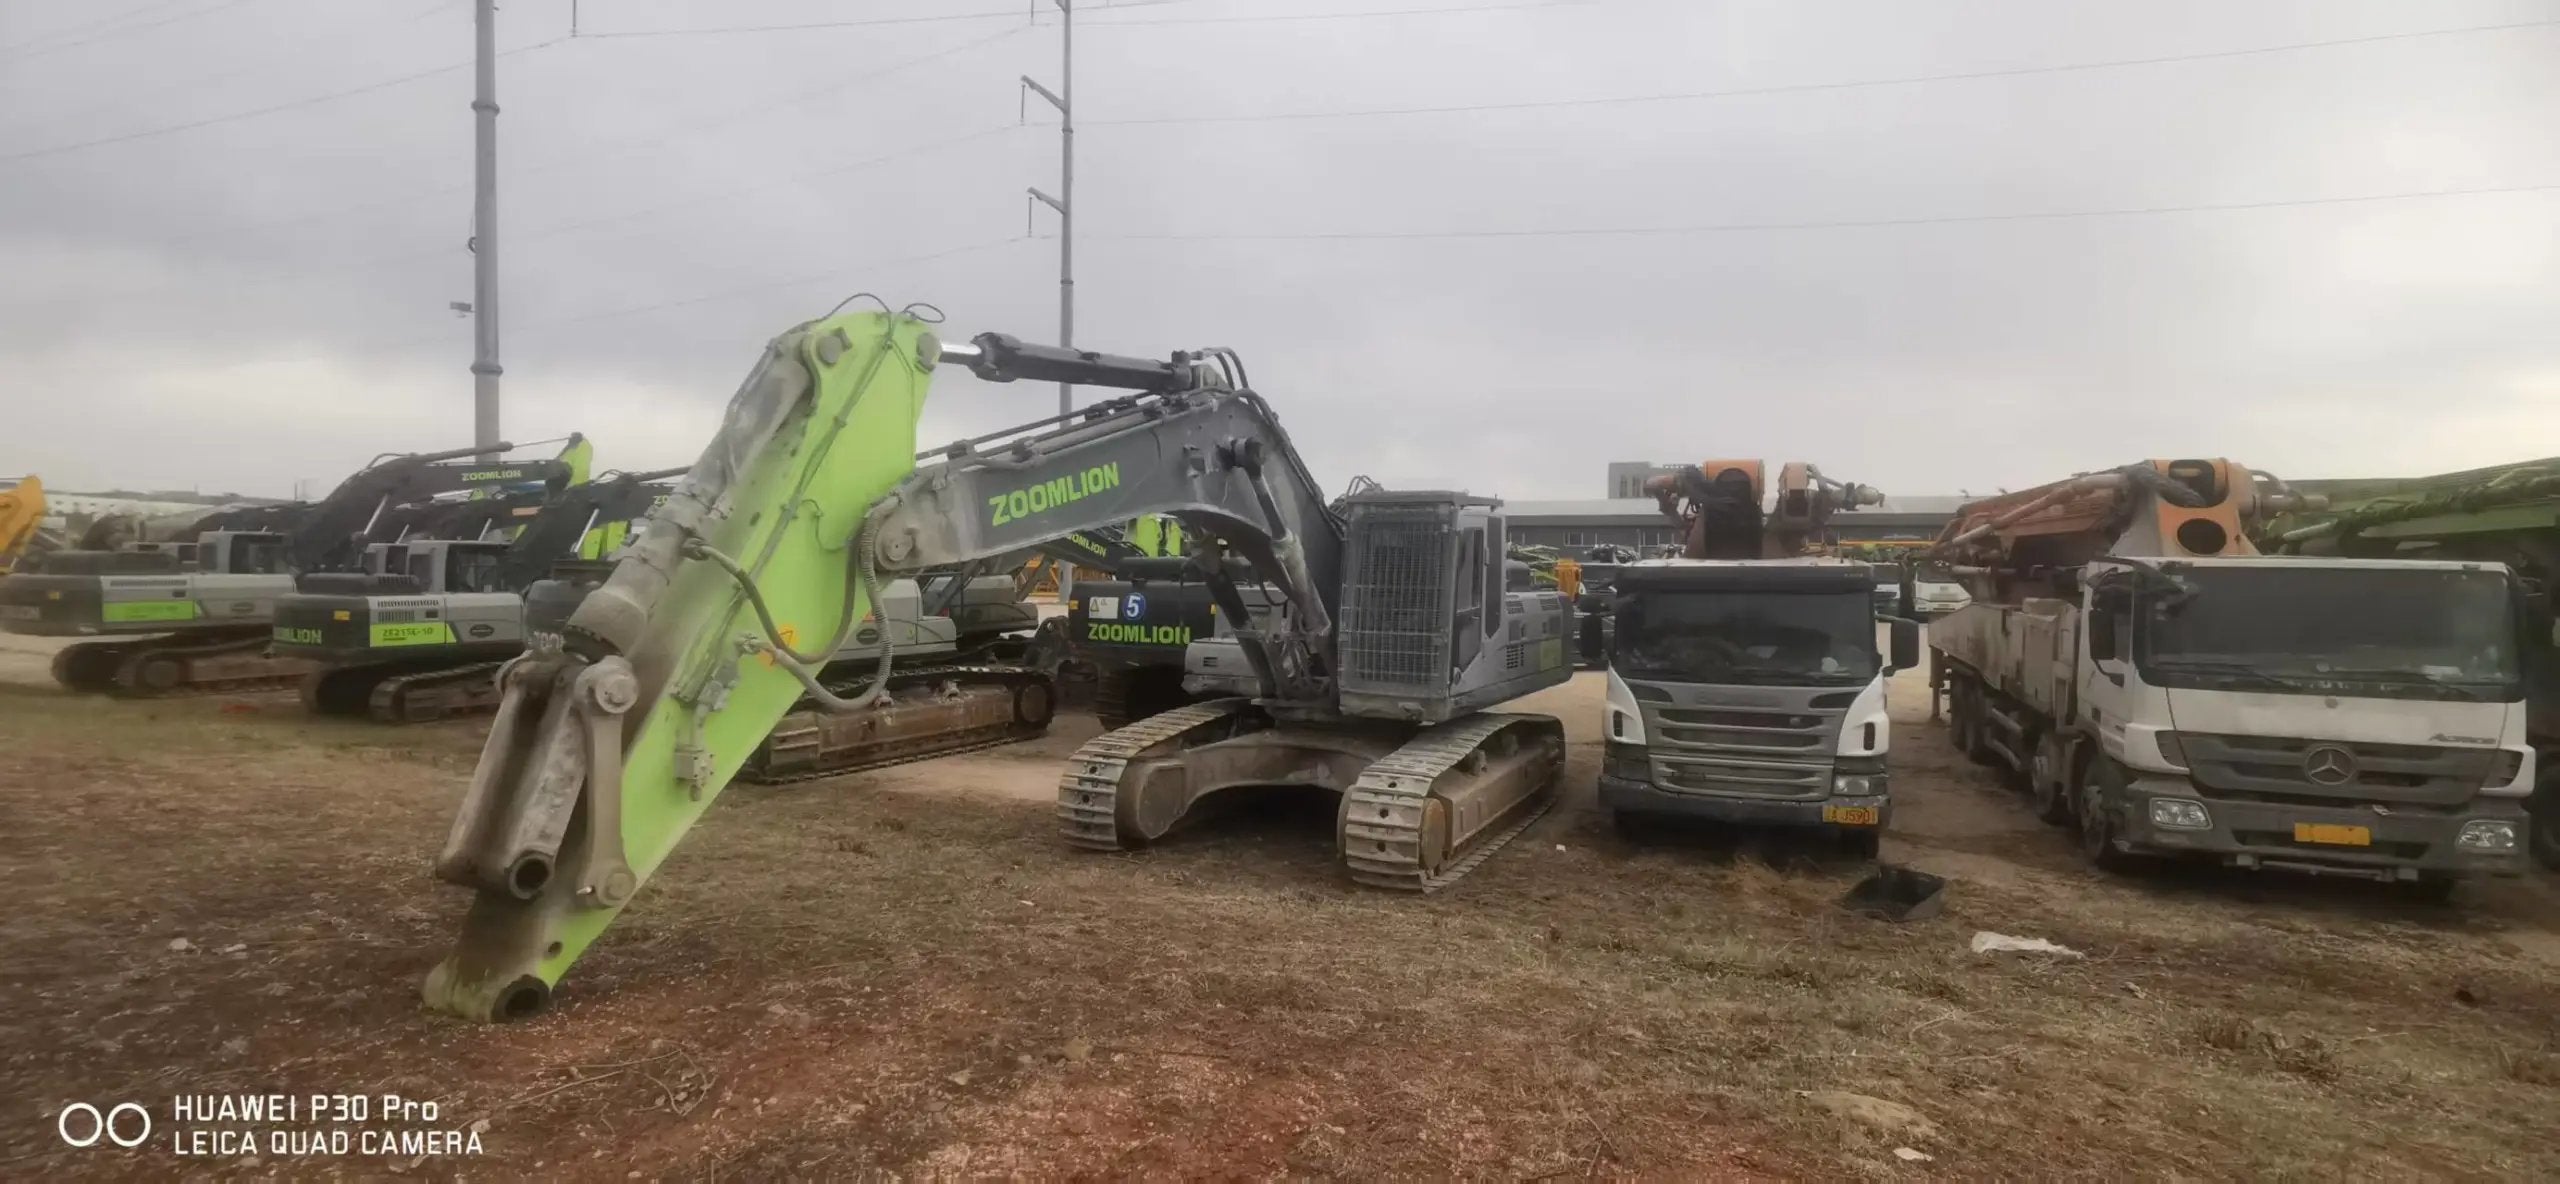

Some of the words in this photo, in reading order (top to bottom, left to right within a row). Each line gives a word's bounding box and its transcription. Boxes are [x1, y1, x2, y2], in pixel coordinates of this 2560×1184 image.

[461, 469, 521, 481] ZOOMLION
[989, 461, 1120, 527] ZOOMLION
[1126, 595, 1141, 618] 5
[1088, 623, 1190, 644] ZOOMLION
